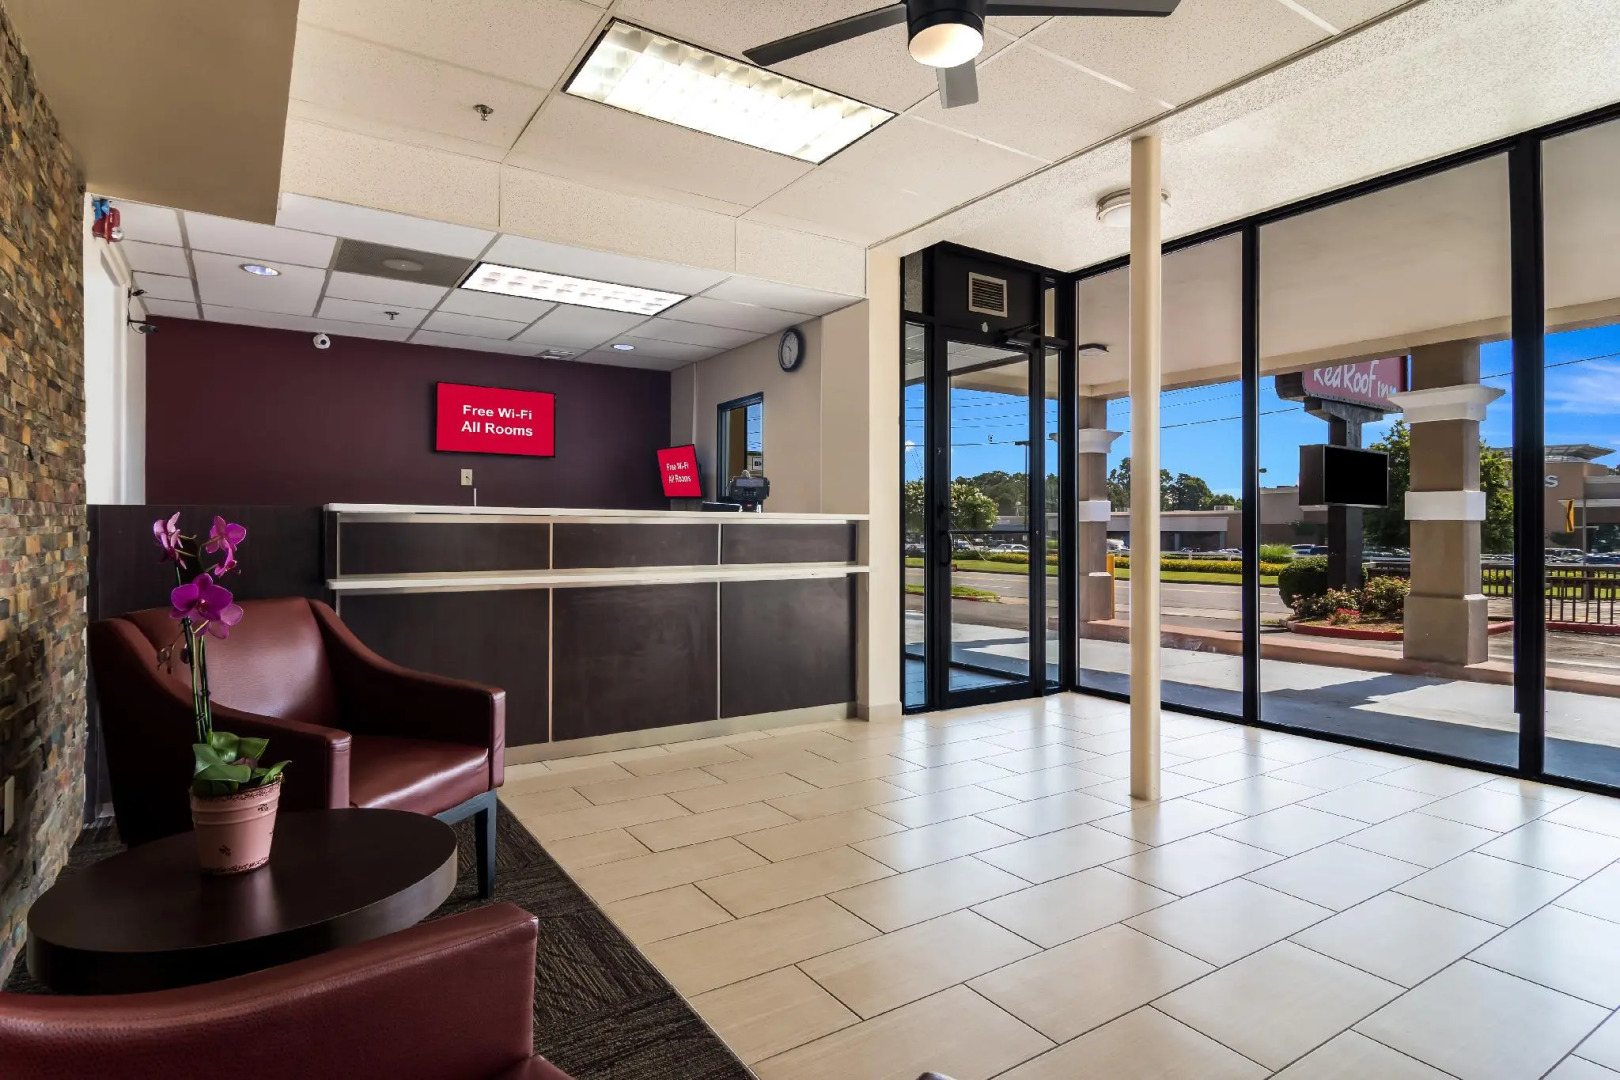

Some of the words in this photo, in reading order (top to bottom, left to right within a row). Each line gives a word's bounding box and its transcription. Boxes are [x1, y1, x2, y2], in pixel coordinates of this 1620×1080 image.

[462, 404, 495, 417] Free
[497, 407, 533, 420] Wi-Fi
[461, 420, 481, 433] All
[484, 422, 533, 437] Rooms
